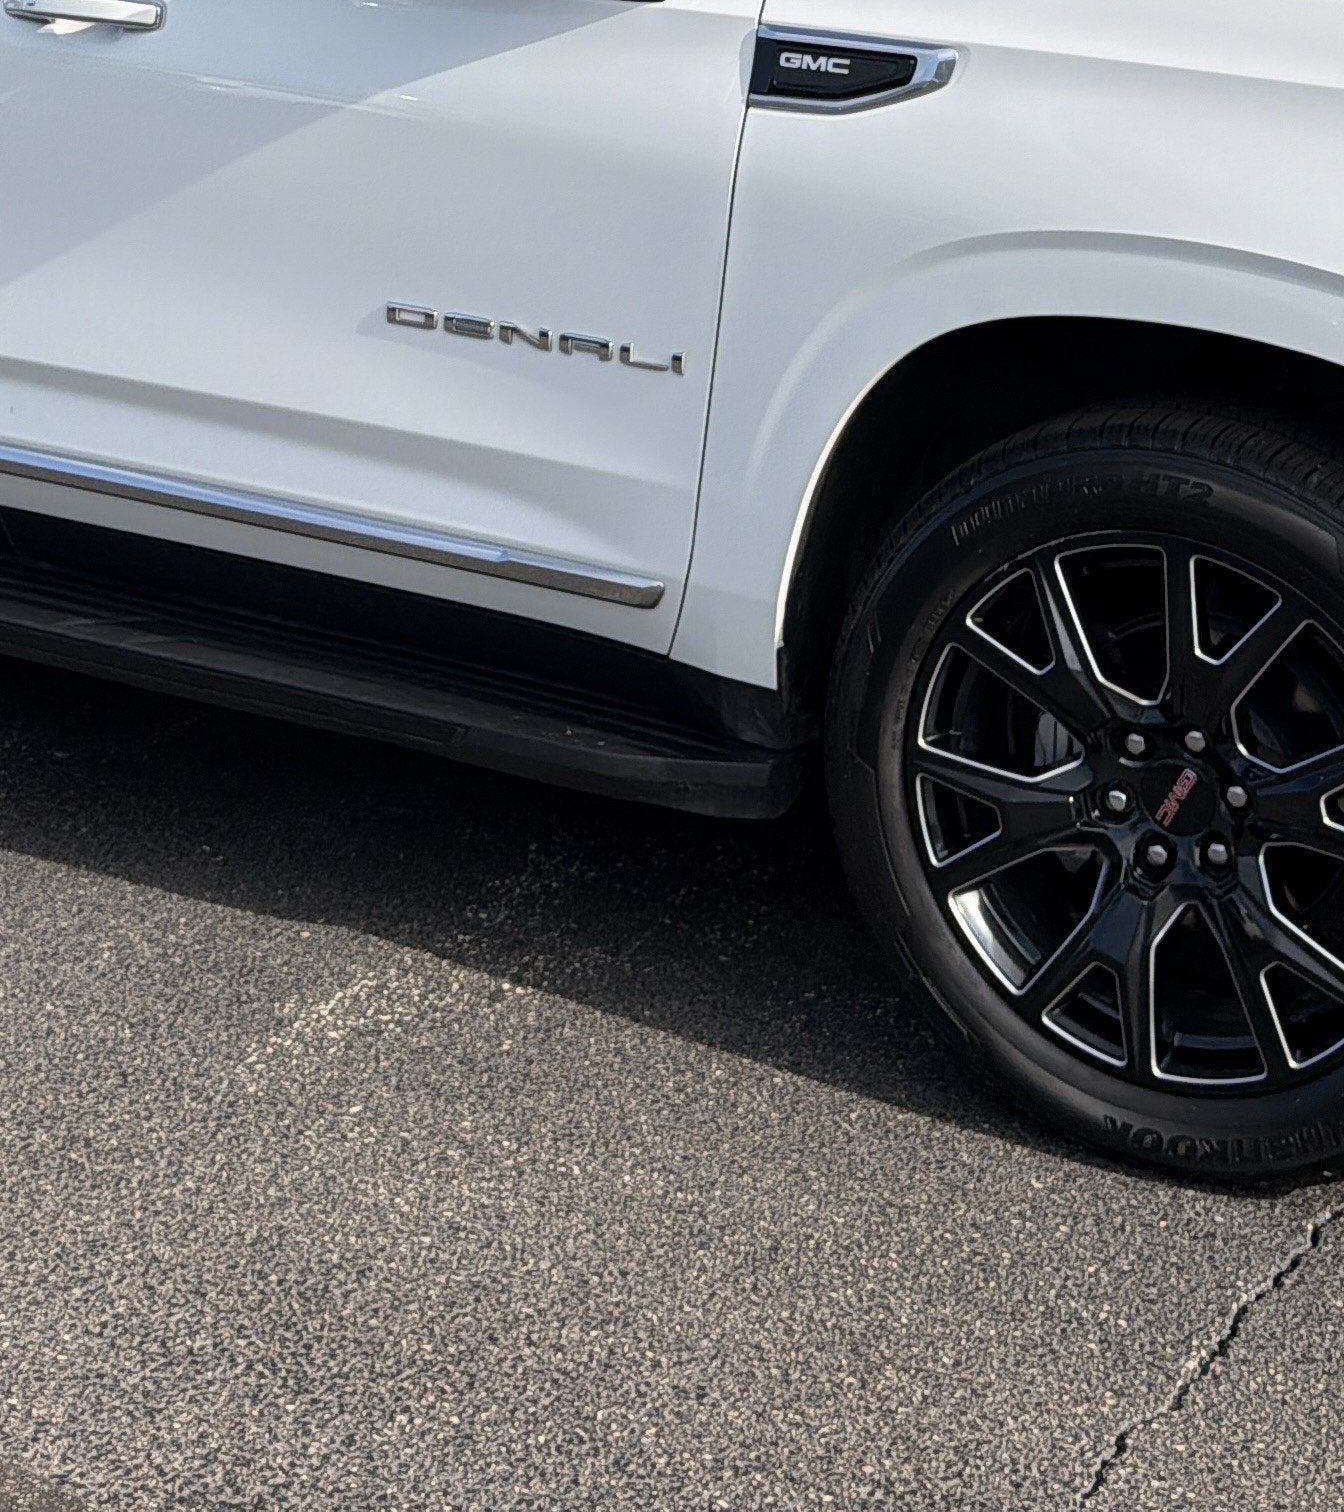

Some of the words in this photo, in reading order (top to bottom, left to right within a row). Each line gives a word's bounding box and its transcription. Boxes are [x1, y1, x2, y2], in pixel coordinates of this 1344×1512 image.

[778, 51, 851, 75] GMC
[386, 300, 687, 376] DENALI
[1155, 768, 1198, 828] GMC
